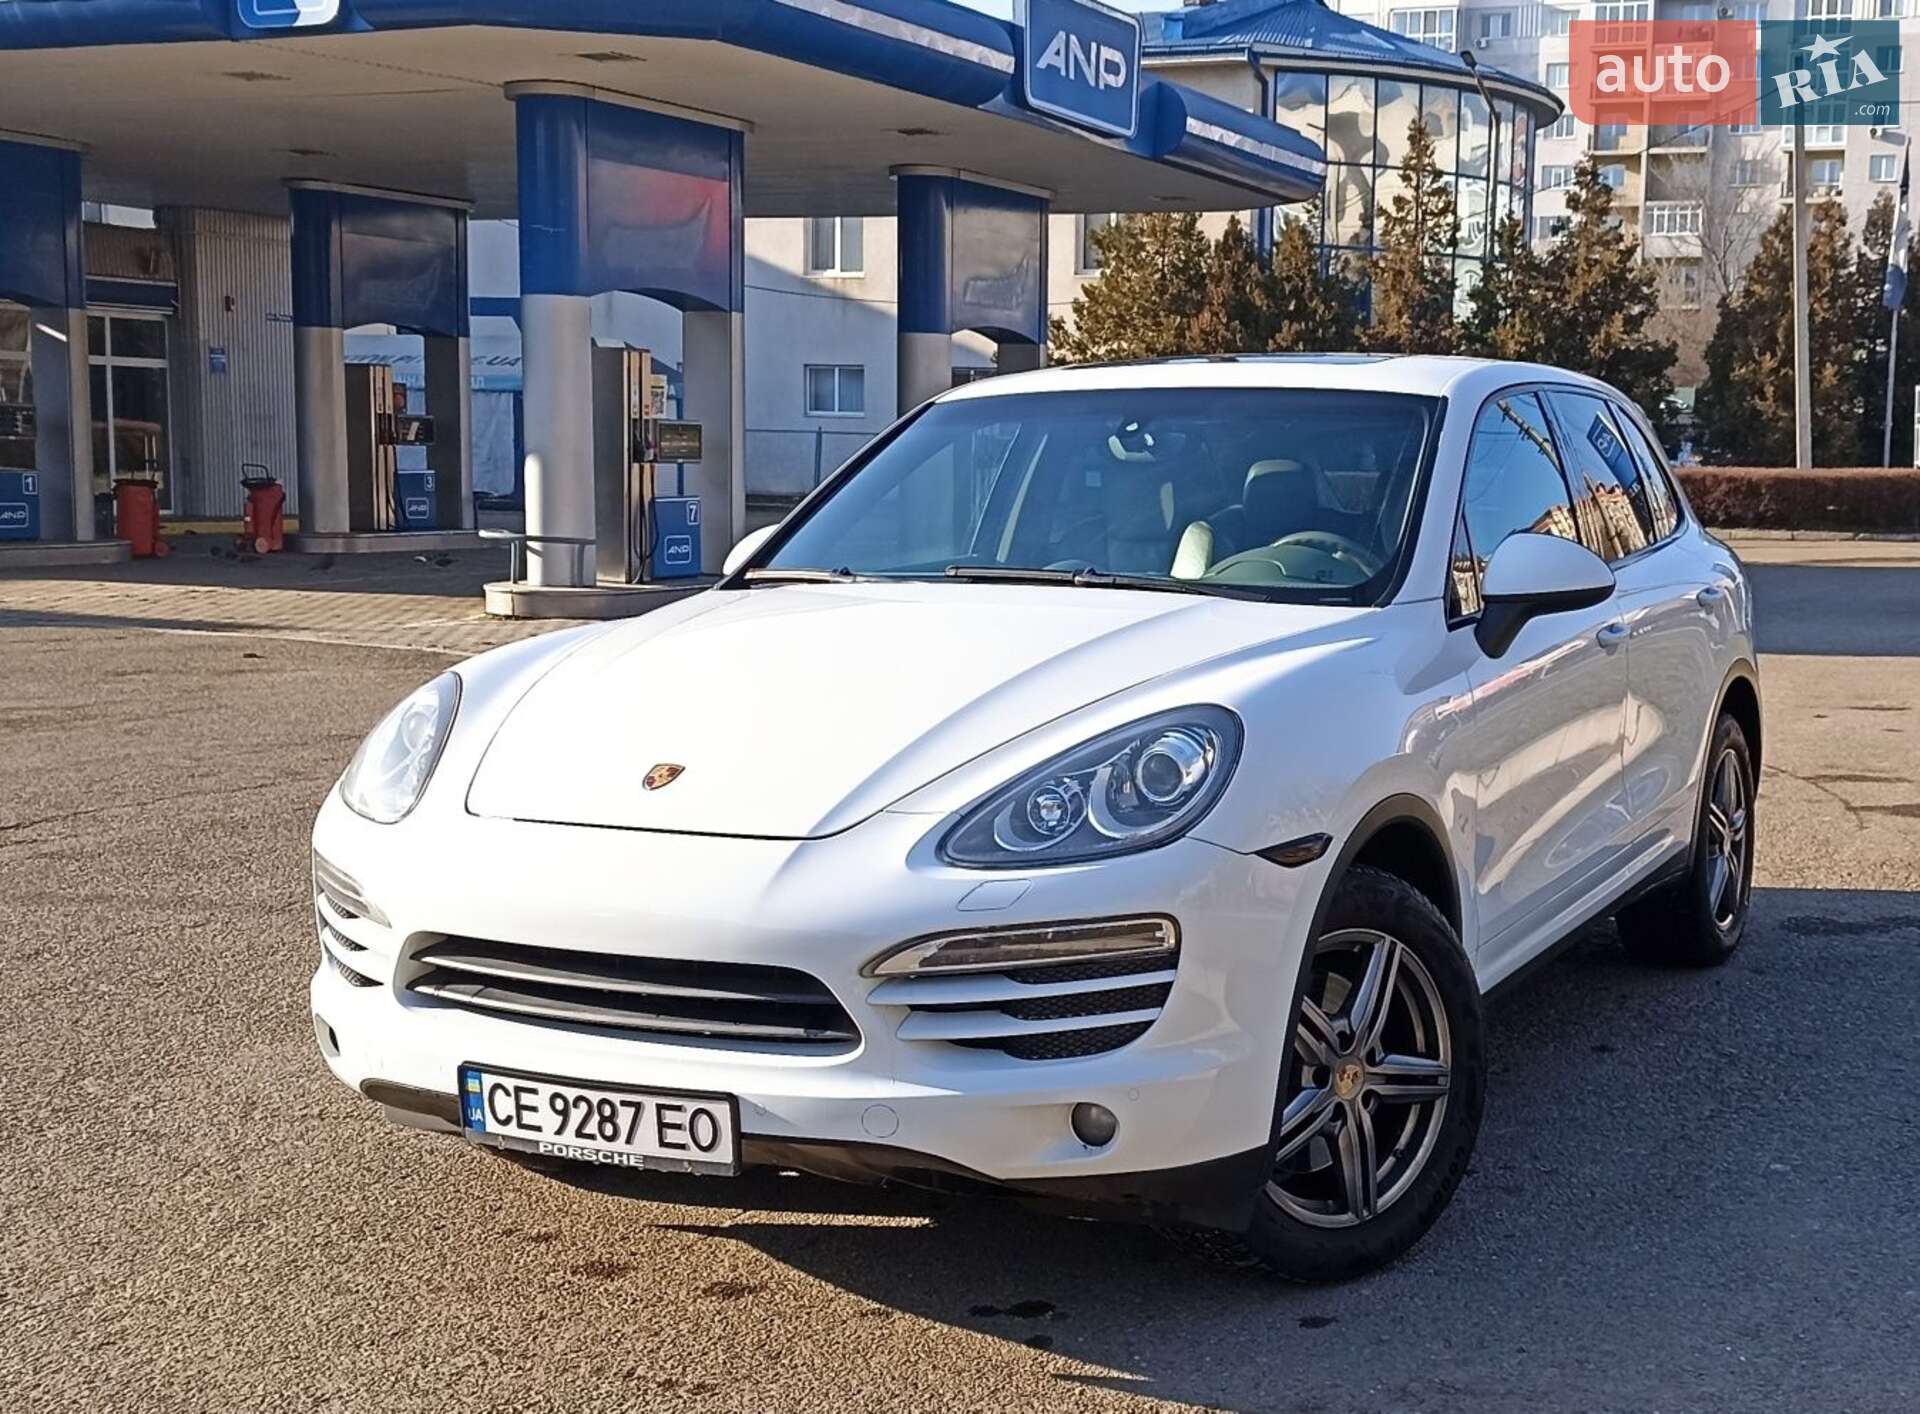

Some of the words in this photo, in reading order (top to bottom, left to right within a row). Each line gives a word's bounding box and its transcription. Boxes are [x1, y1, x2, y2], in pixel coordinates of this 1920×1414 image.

[1036, 30, 1127, 90] ANP
[25, 476, 33, 492] 1
[426, 476, 433, 489] 3
[689, 504, 697, 521] 7
[467, 1107, 484, 1122] UA
[488, 1083, 543, 1132] CE
[549, 1092, 642, 1145] 9287
[655, 1103, 719, 1152] EO
[539, 1142, 645, 1168] PORSCHE
